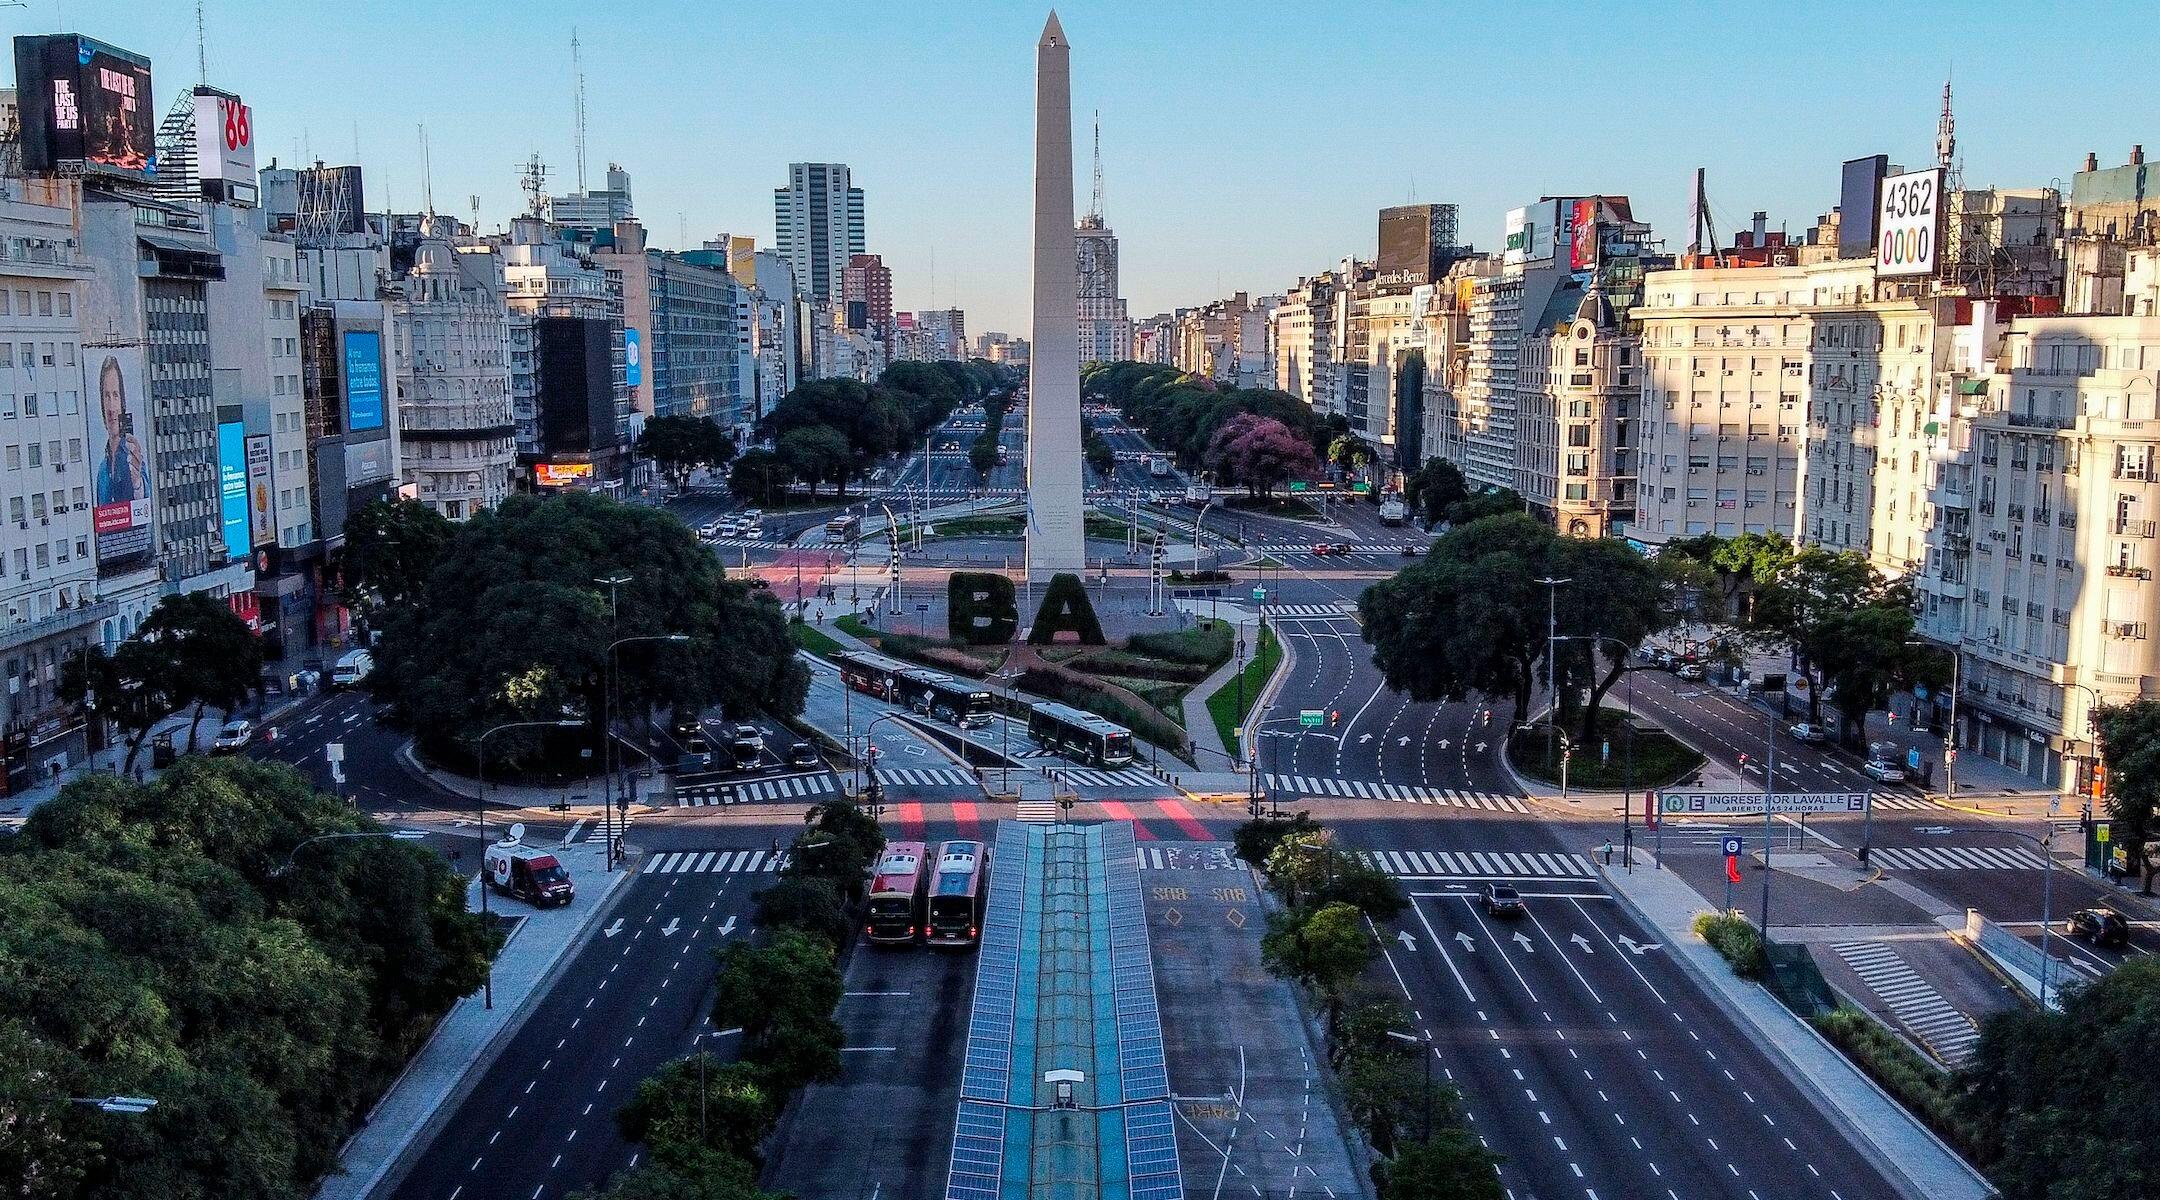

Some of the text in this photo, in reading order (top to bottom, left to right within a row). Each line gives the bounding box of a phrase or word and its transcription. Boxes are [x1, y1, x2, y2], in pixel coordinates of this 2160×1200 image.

[54, 80, 69, 93] THE
[100, 67, 110, 90] THE
[110, 70, 121, 93] LAST
[128, 76, 135, 98] US
[55, 93, 75, 106] LAST
[56, 106, 78, 120] OF US
[56, 119, 71, 129] PART
[1886, 179, 1932, 218] 4362
[1884, 226, 1928, 265] 0000
[948, 572, 1107, 645] BA
[1709, 795, 1844, 804] INGRESE POR LAVALLE
[1153, 887, 1246, 901] BUS BUS
